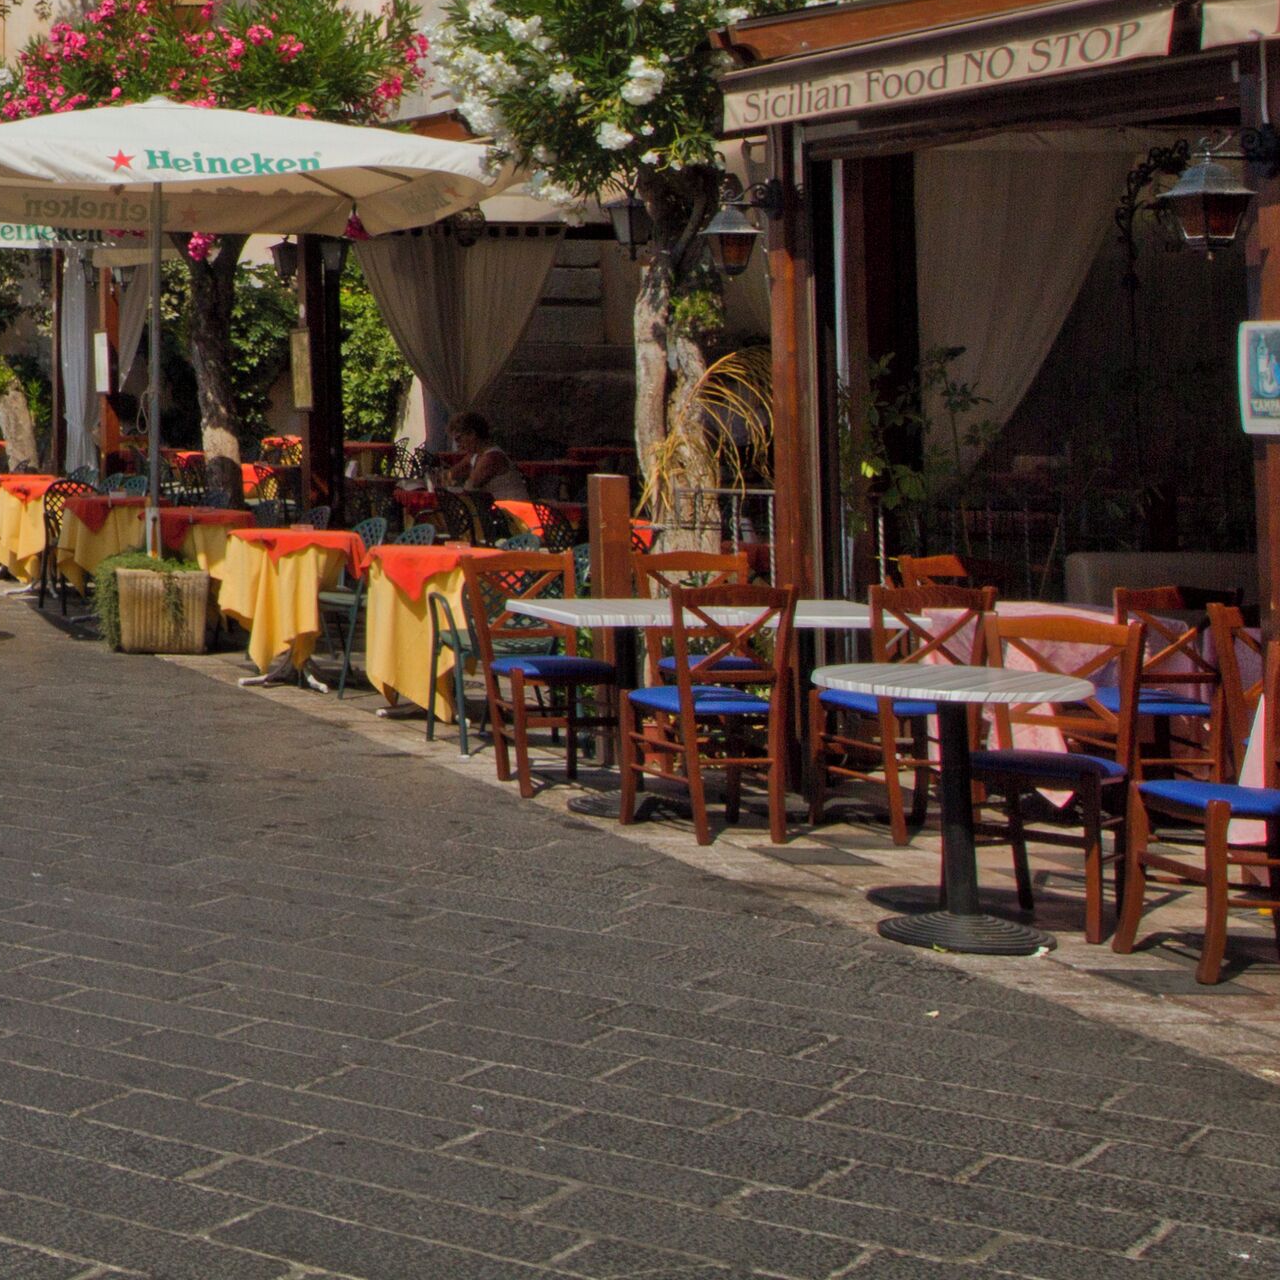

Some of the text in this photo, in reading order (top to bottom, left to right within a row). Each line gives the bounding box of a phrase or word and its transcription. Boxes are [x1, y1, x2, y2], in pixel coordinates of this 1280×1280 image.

[742, 20, 1142, 124] Sicilian Food NO STOP
[144, 148, 320, 174] Heineken
